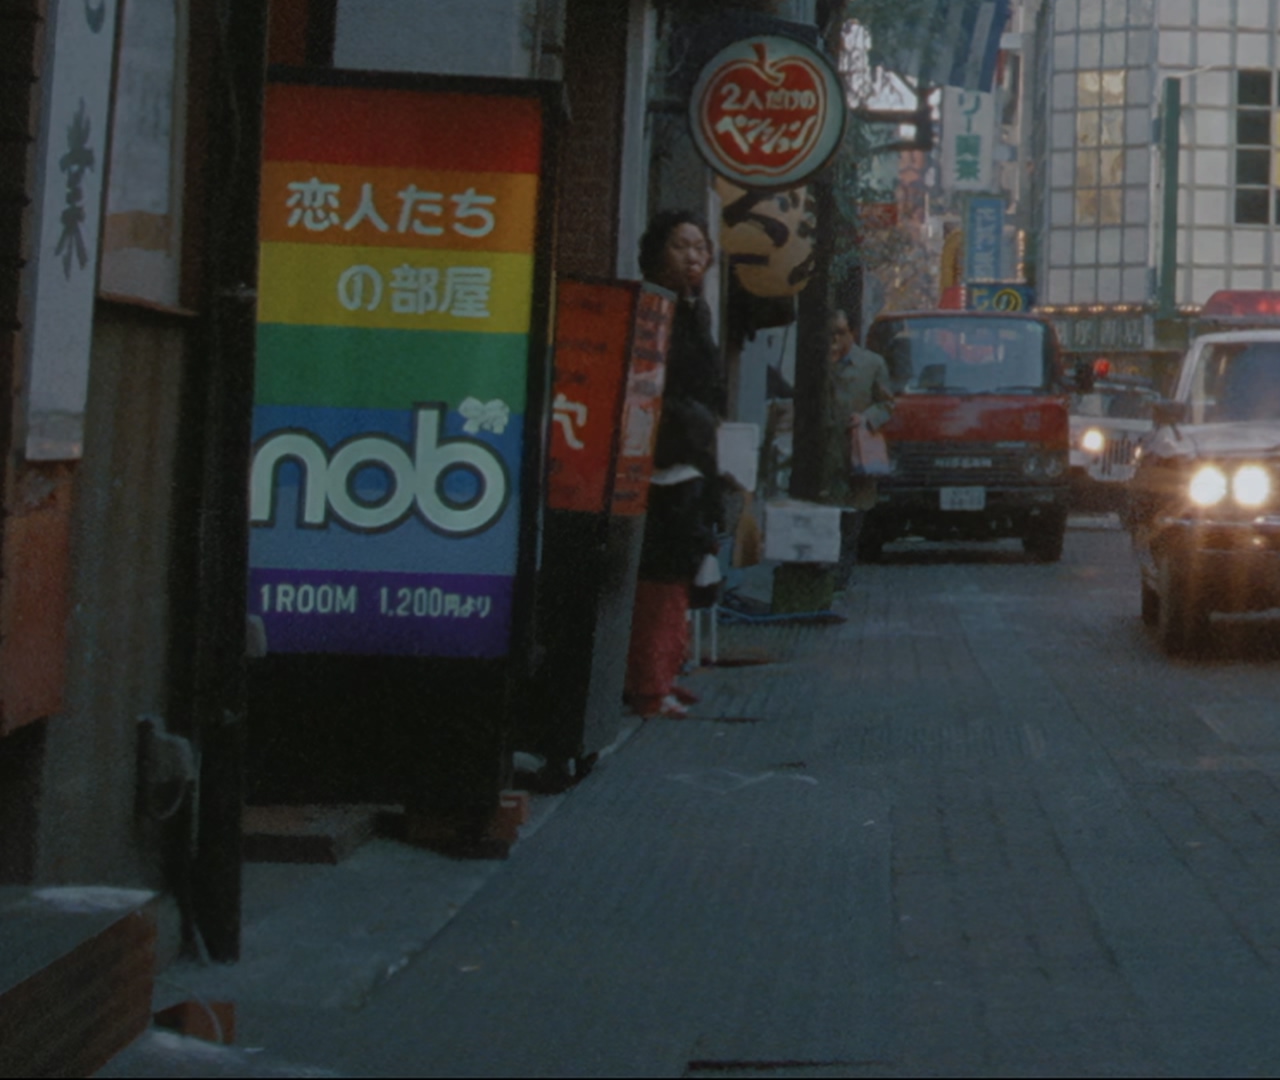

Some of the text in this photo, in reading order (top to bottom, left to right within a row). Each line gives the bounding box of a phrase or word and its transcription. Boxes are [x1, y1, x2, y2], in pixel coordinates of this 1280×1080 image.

[286, 180, 496, 238] 恋人たち
[337, 266, 492, 318] の部屋
[251, 404, 508, 533] nob
